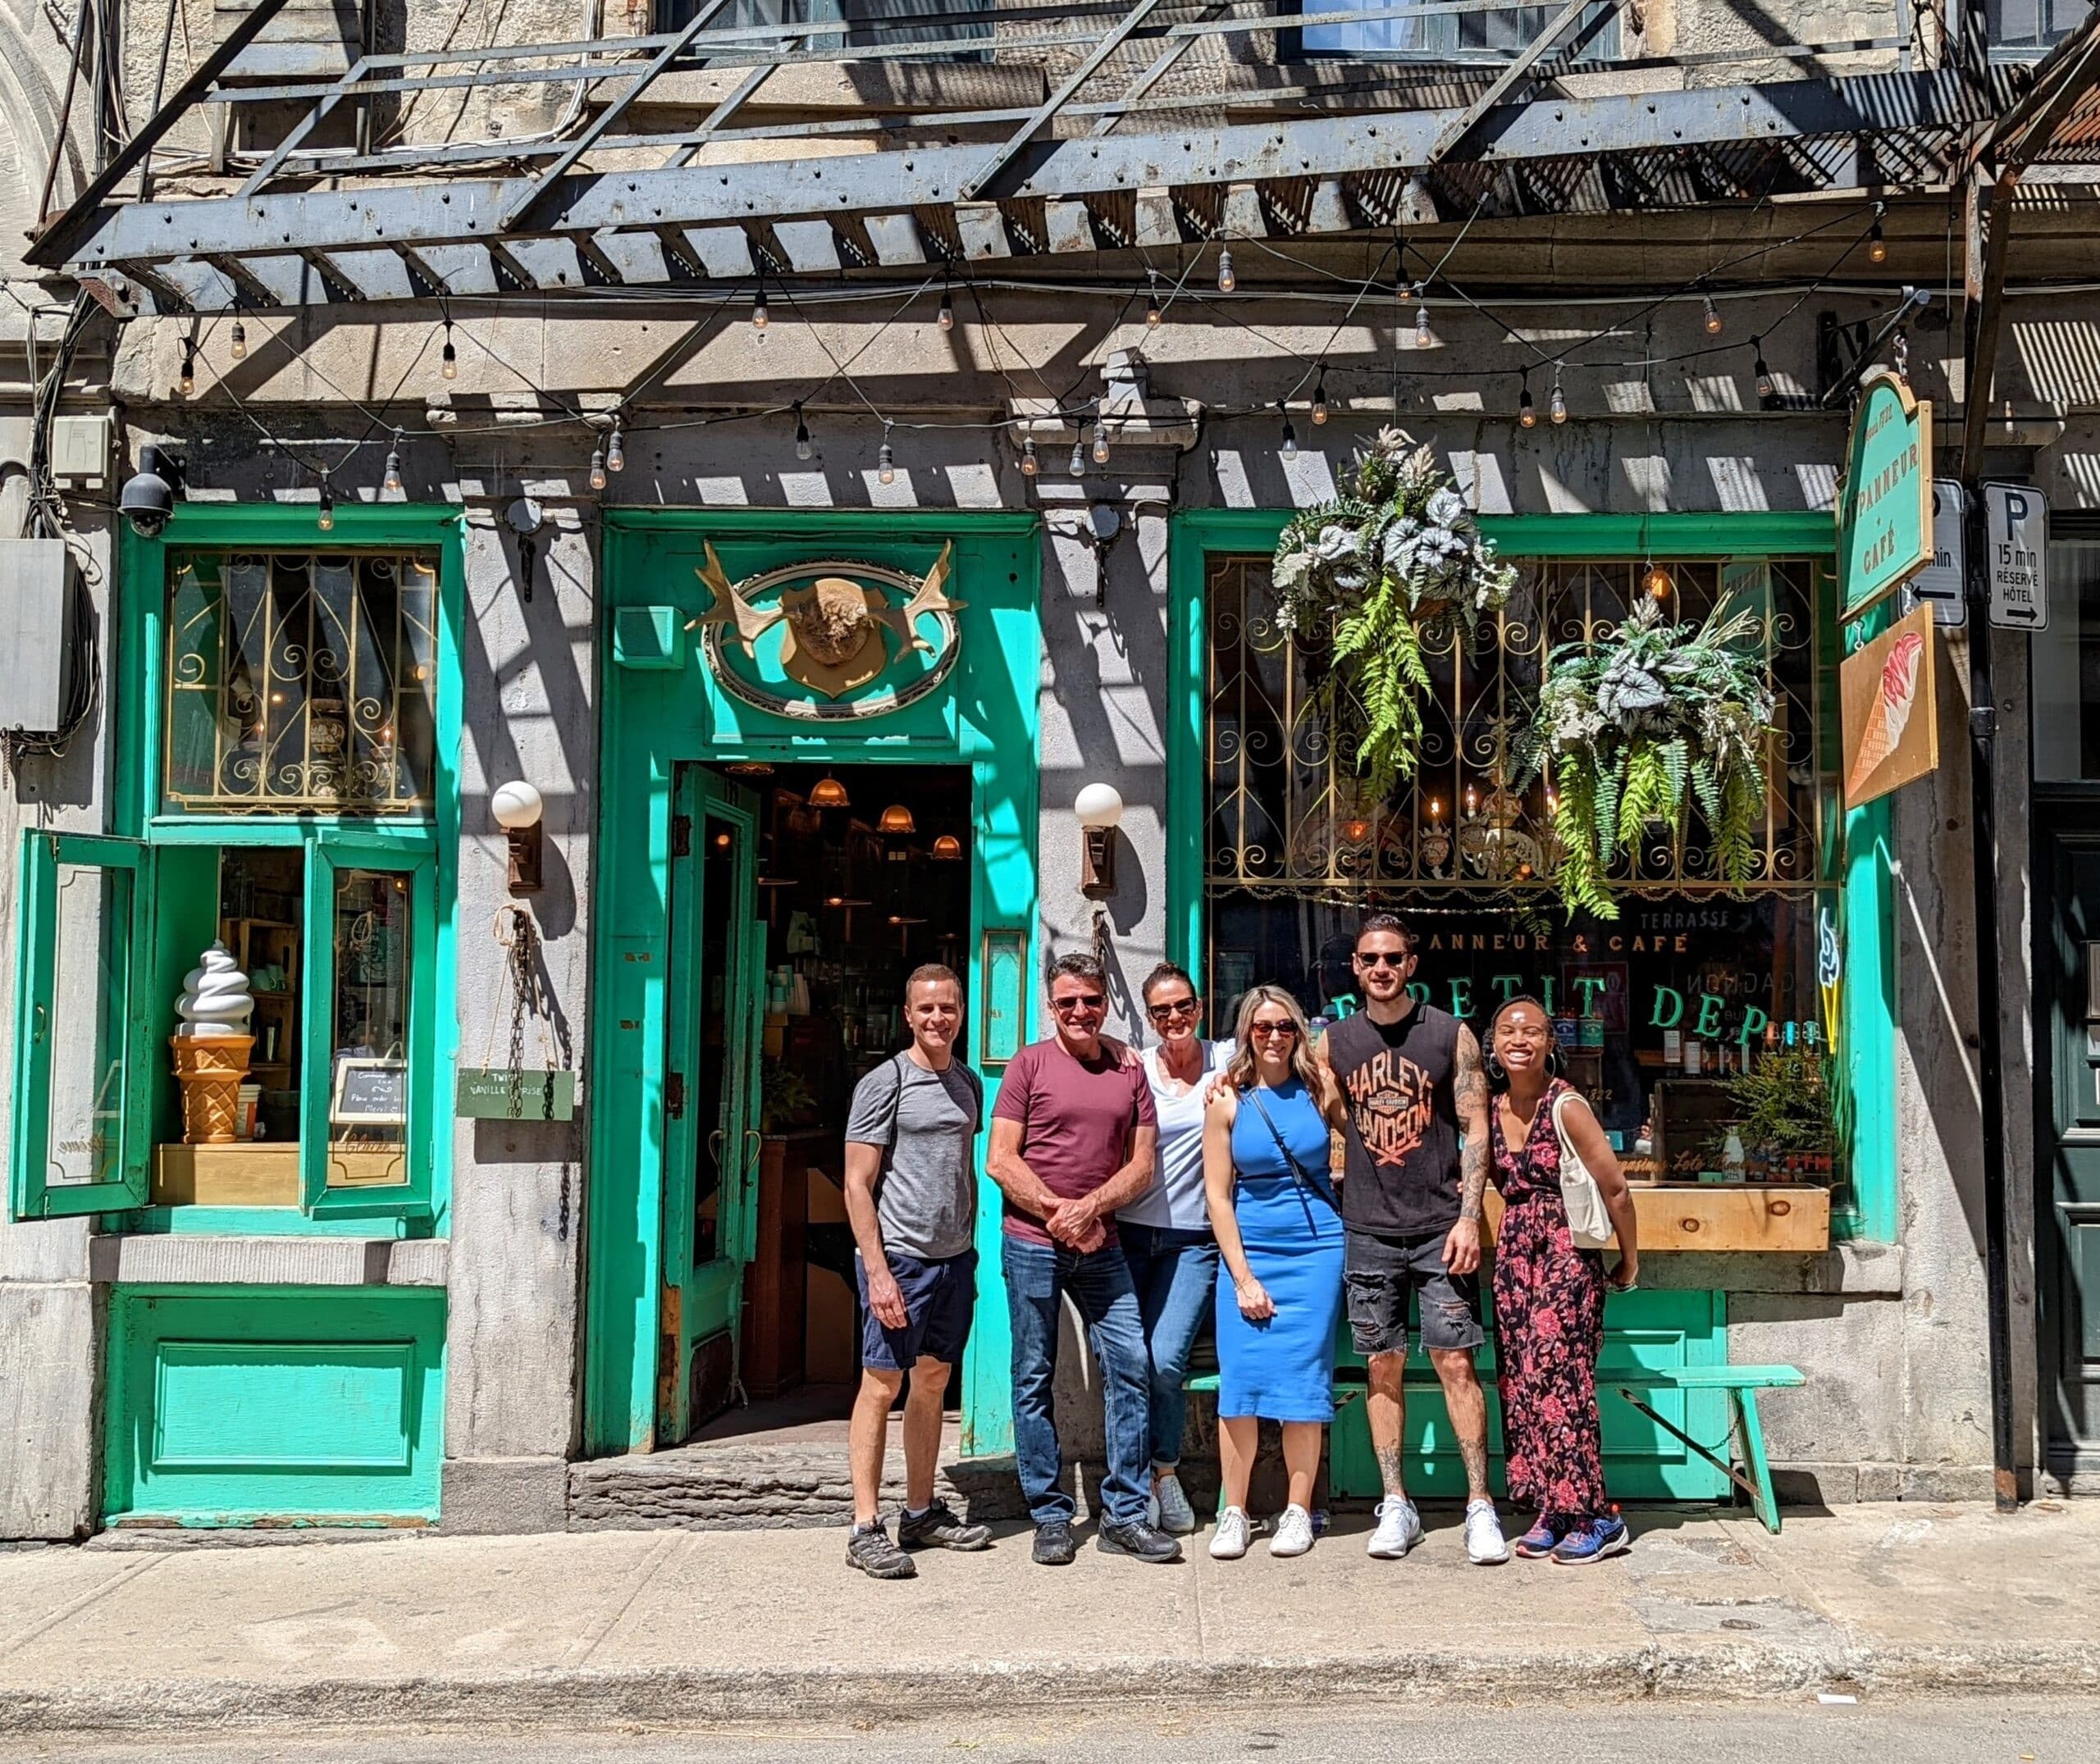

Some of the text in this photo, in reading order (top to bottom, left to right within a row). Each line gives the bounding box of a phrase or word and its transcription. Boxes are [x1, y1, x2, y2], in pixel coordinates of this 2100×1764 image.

[2004, 492, 2029, 541] P
[1863, 519, 1895, 575] CAFÉ
[1998, 544, 2037, 567] 15 min
[1997, 567, 2038, 586] RÉSERVÉ
[2003, 586, 2033, 603] HÔTEL
[1641, 909, 1729, 930] TERRASSE
[1573, 934, 1588, 952] &
[1609, 932, 1687, 952] CAFÉ
[1648, 984, 1768, 1046] DEP
